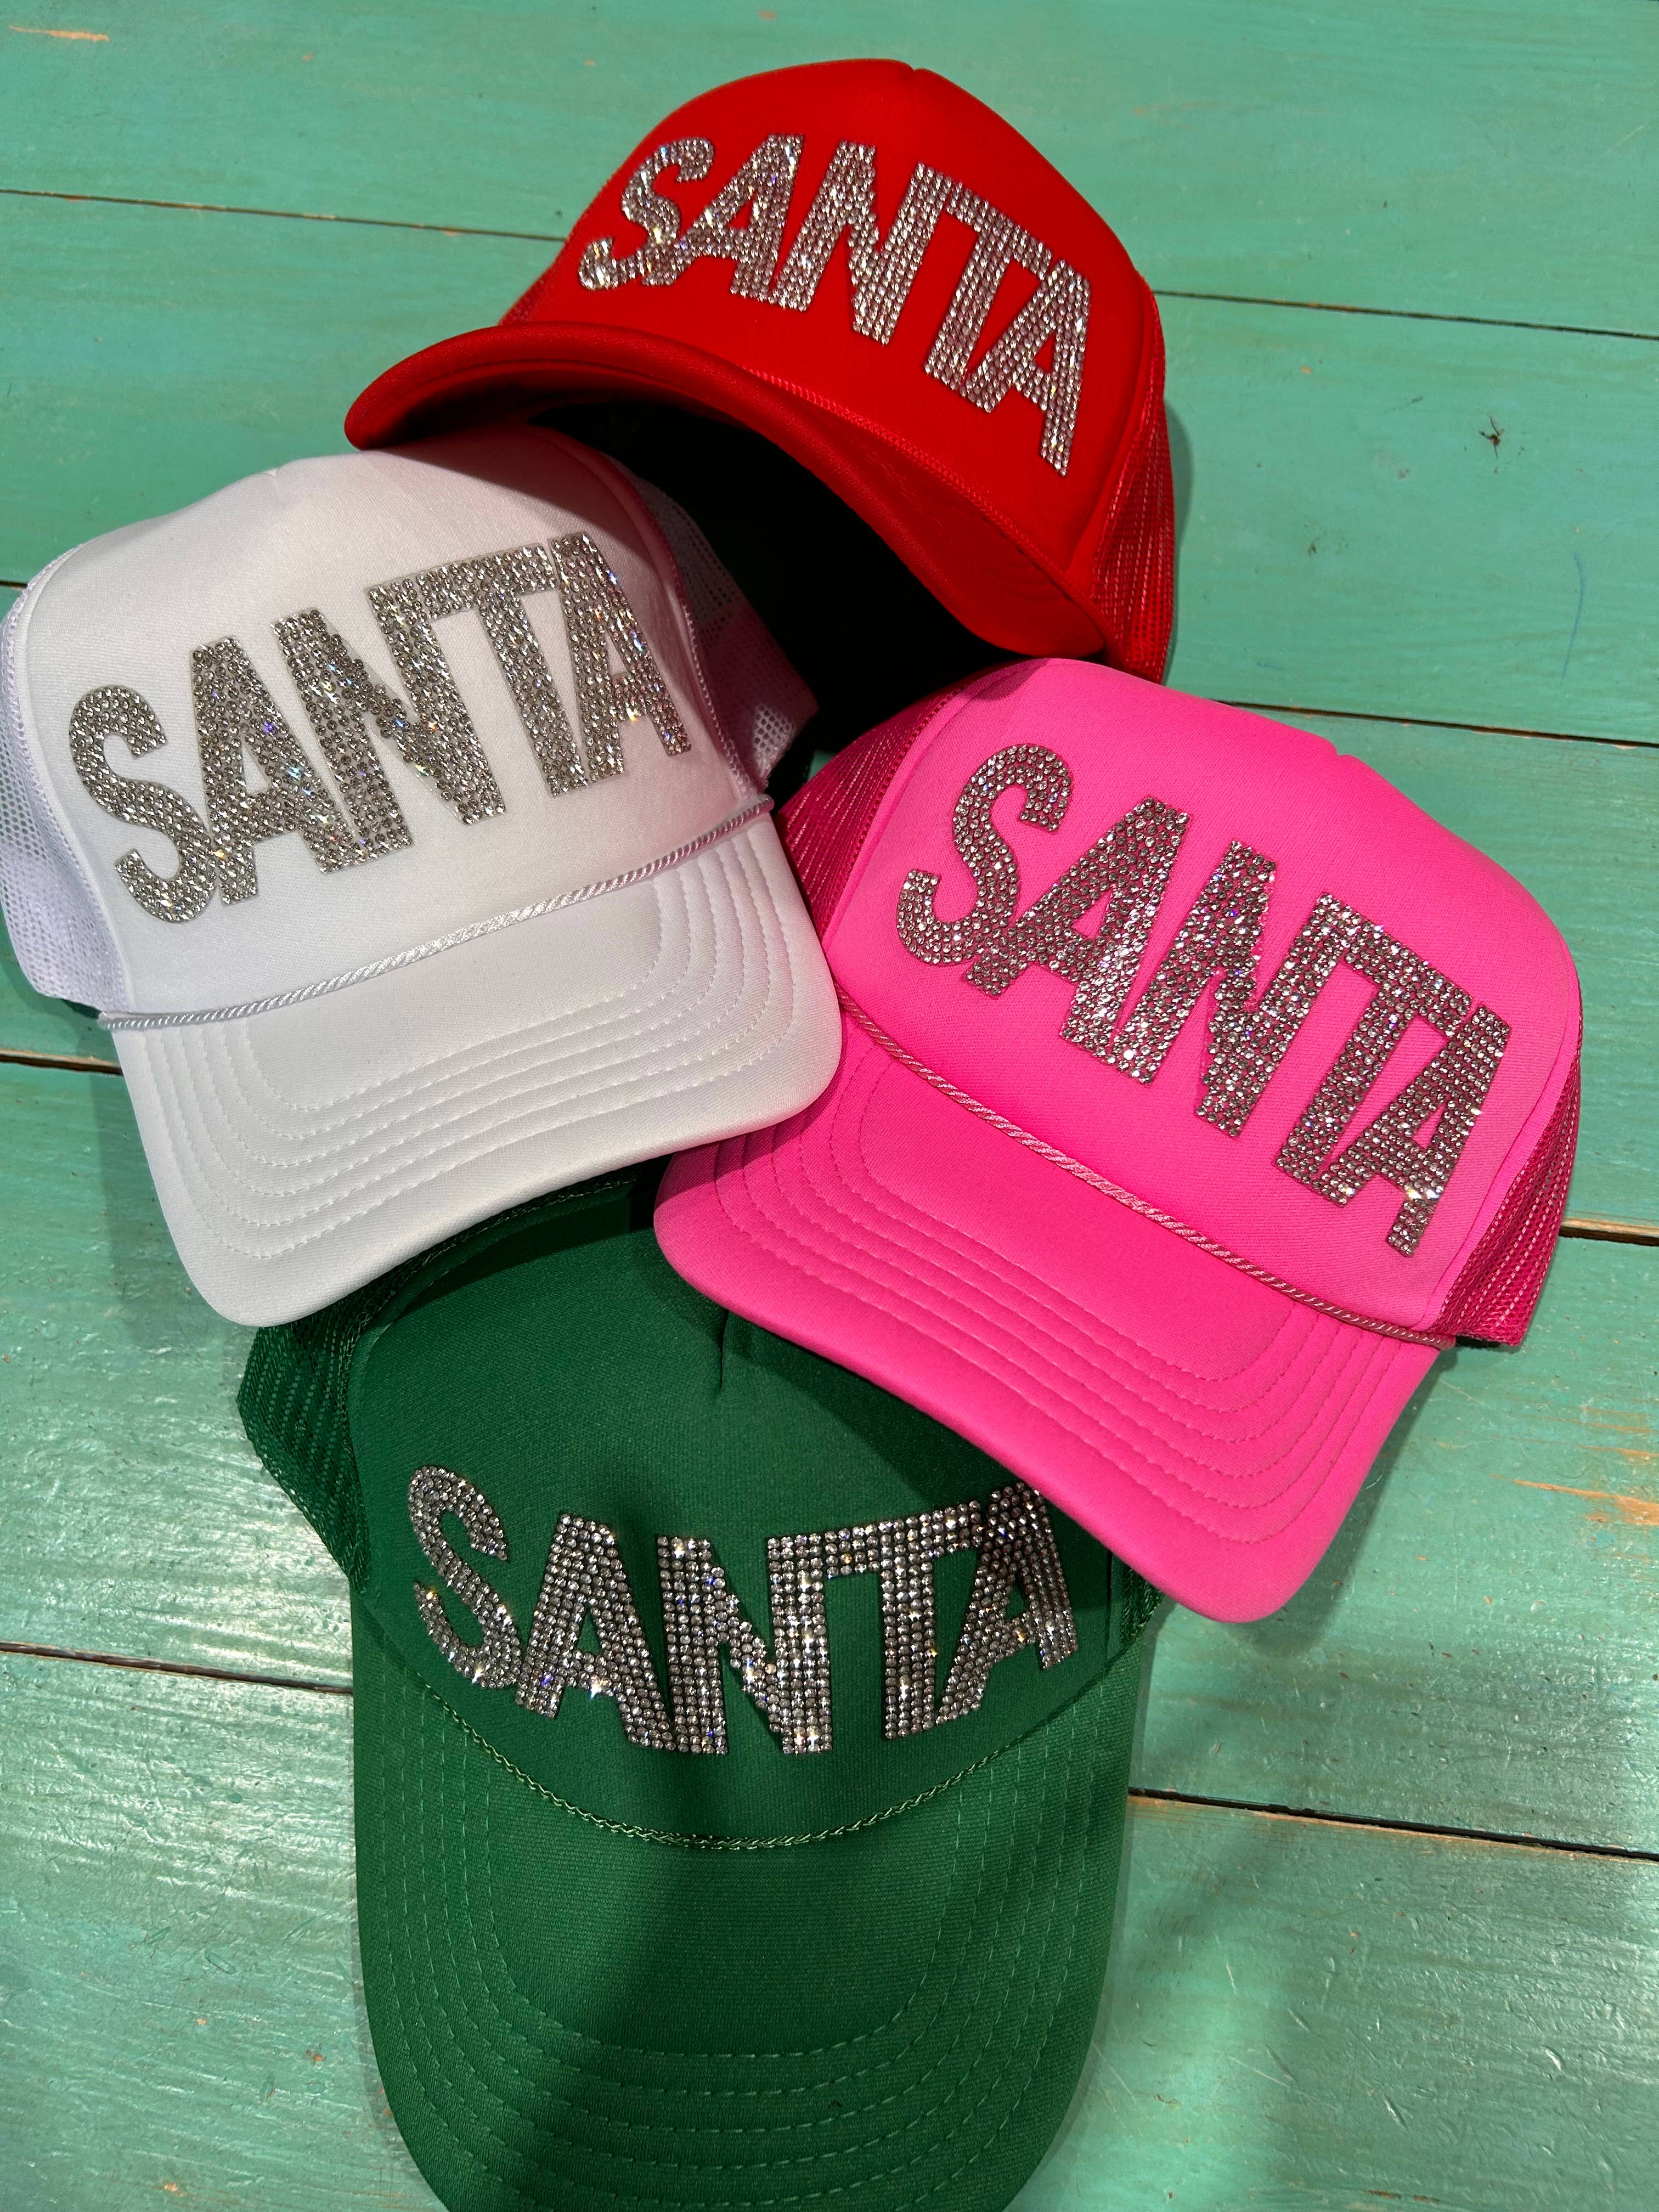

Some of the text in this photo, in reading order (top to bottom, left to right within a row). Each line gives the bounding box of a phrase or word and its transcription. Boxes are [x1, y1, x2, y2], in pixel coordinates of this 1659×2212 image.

[580, 133, 1091, 476] SANTA
[70, 532, 690, 924] SANTA
[897, 743, 1511, 1256] SANTA
[407, 1465, 1078, 1755] SANTA
